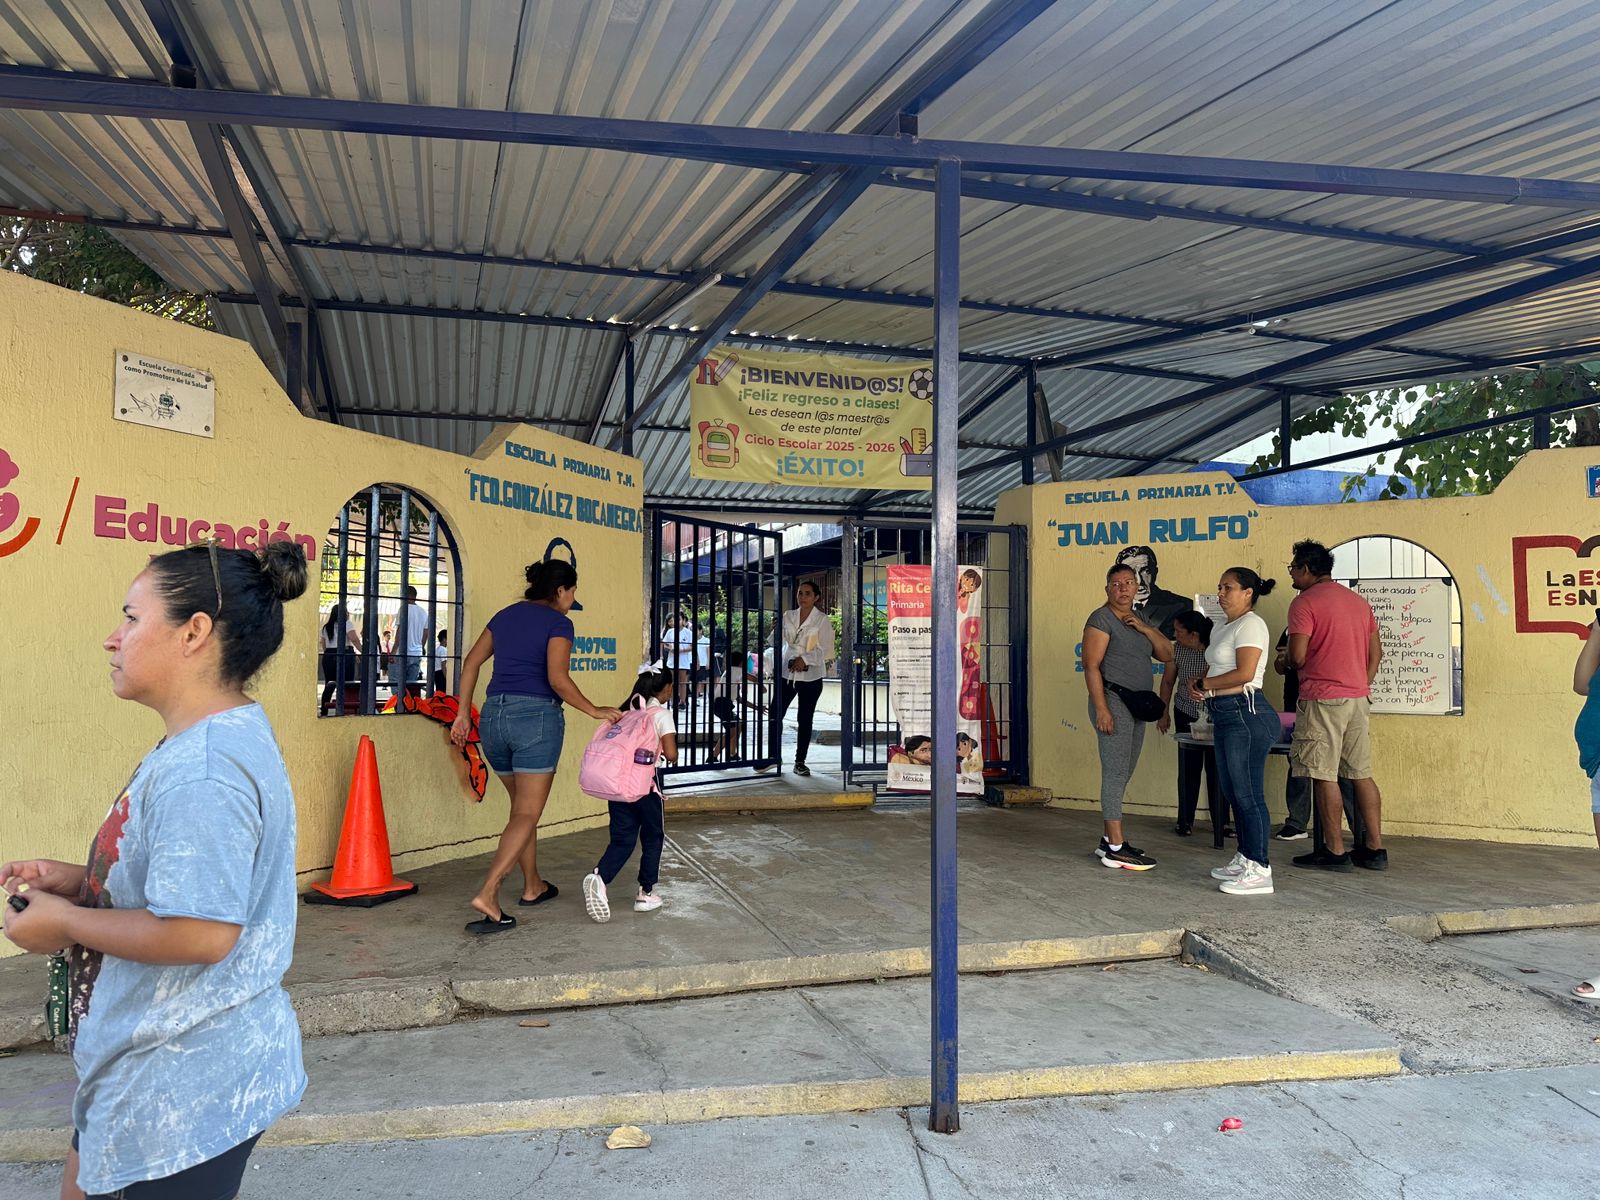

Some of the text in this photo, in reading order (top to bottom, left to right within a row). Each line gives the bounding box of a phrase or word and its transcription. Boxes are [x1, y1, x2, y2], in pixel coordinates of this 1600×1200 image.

[138, 360, 195, 379] Escuela Certificada
[124, 365, 142, 374] como
[143, 369, 175, 382] Promotora
[192, 381, 208, 390] Salud
[741, 367, 904, 396] ¡BIENVENID@S!
[738, 388, 899, 410] ¡Feliz regreso a clases!
[748, 406, 890, 426] Les desean l@s maestr@s
[781, 422, 862, 436] de este plantel
[744, 434, 775, 446] Ciclo
[778, 437, 823, 450] Escolar
[825, 441, 855, 452] 2025
[865, 442, 895, 453] 2026
[505, 440, 556, 468] ESCUELA
[563, 457, 611, 482] PRIMARIA
[776, 451, 865, 478] ¡ÉXITO!
[1065, 482, 1237, 505] ESCUELA PRIMARIA T.V.
[576, 496, 643, 533] BOCANEGRA
[889, 582, 914, 594] Rita
[915, 582, 932, 594] Ce
[1356, 584, 1378, 594] Tacos
[1379, 586, 1389, 594] de
[1390, 586, 1416, 594] asada
[890, 600, 925, 609] Primaria
[1401, 612, 1432, 625] totopos
[892, 625, 911, 634] Paso
[918, 627, 932, 636] pas
[1387, 649, 1400, 657] de
[1401, 650, 1434, 661] pierna
[570, 657, 617, 671] ECTOR:15
[1398, 665, 1429, 678] pierna
[1379, 677, 1391, 686] de
[1394, 676, 1423, 686] huevo
[1381, 685, 1393, 693] de
[1386, 696, 1401, 704] con
[902, 775, 924, 783] México
